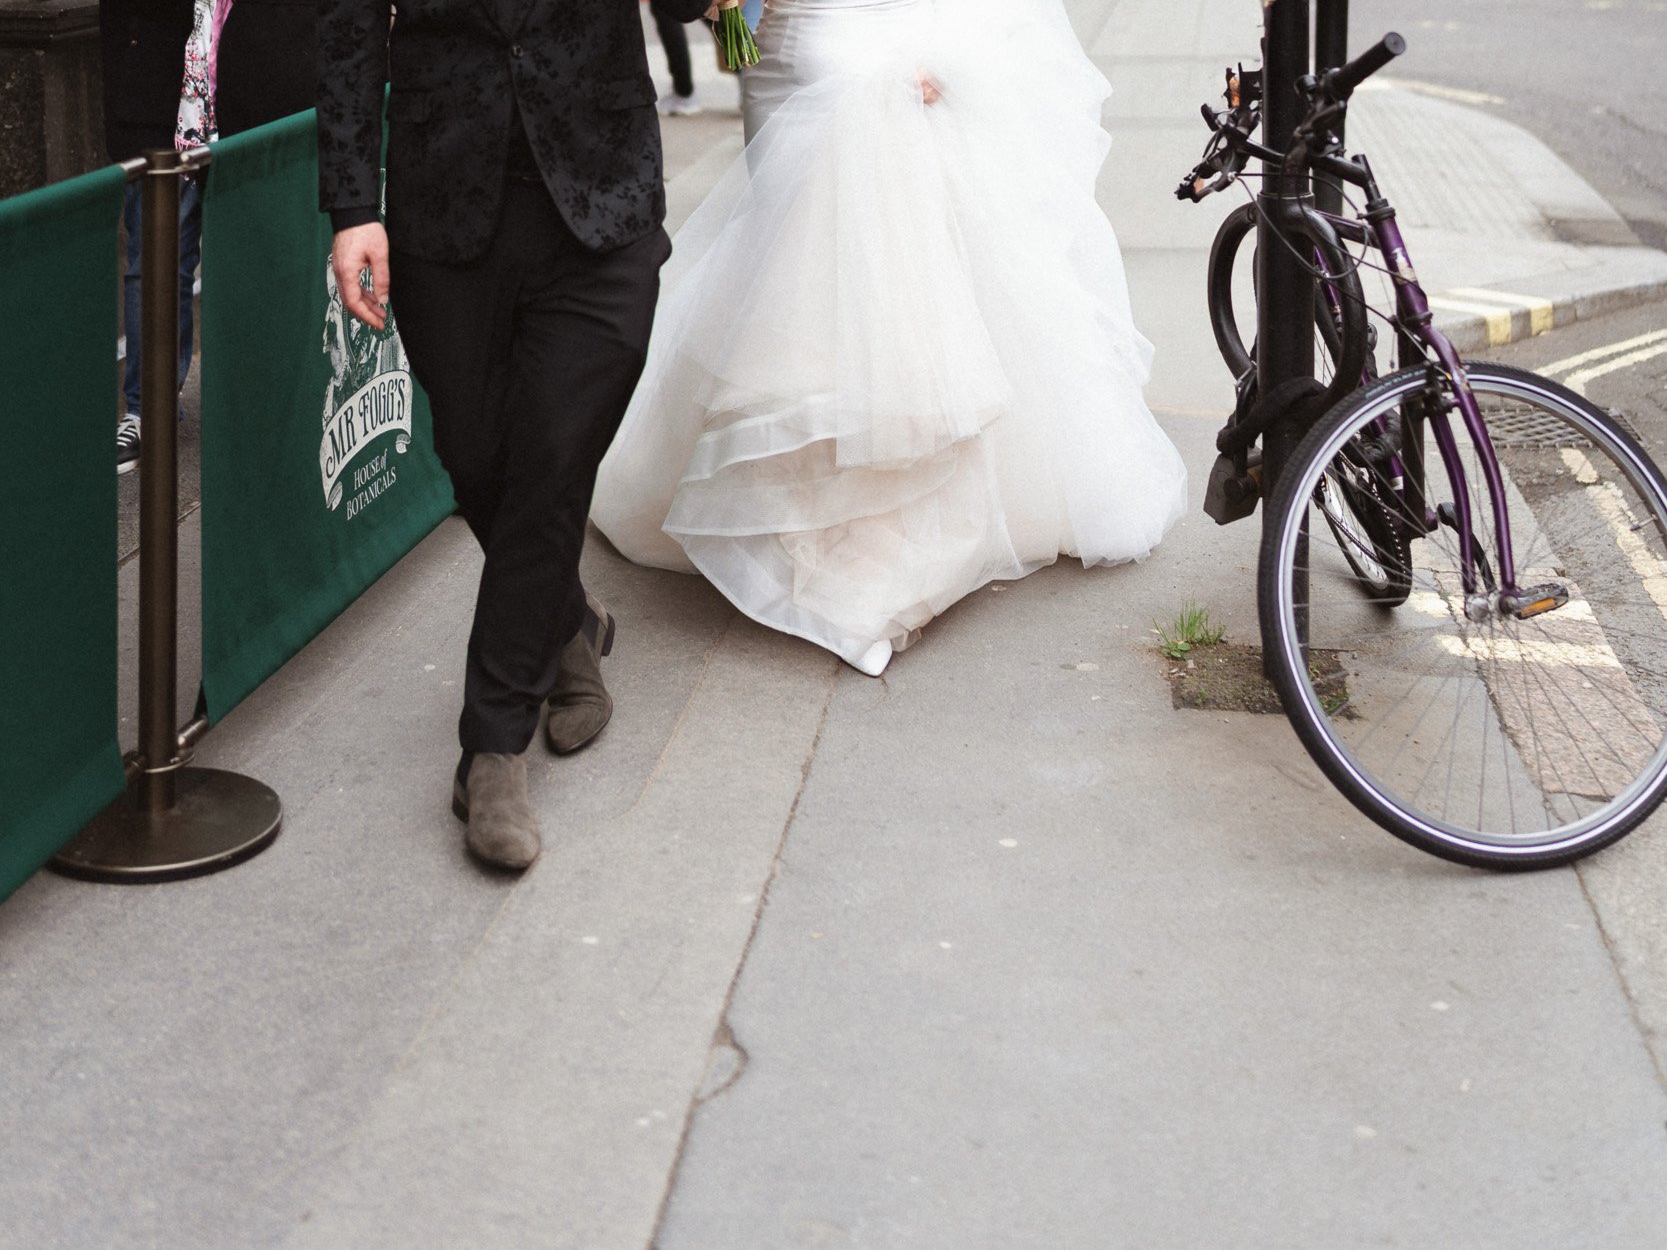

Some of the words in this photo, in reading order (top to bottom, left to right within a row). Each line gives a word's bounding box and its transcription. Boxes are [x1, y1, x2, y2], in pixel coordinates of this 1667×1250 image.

[326, 405, 355, 479] MR
[358, 377, 406, 438] FOGG'S
[346, 466, 397, 522] BOTANICALS
[353, 456, 380, 491] HOUSE
[380, 448, 388, 471] of
